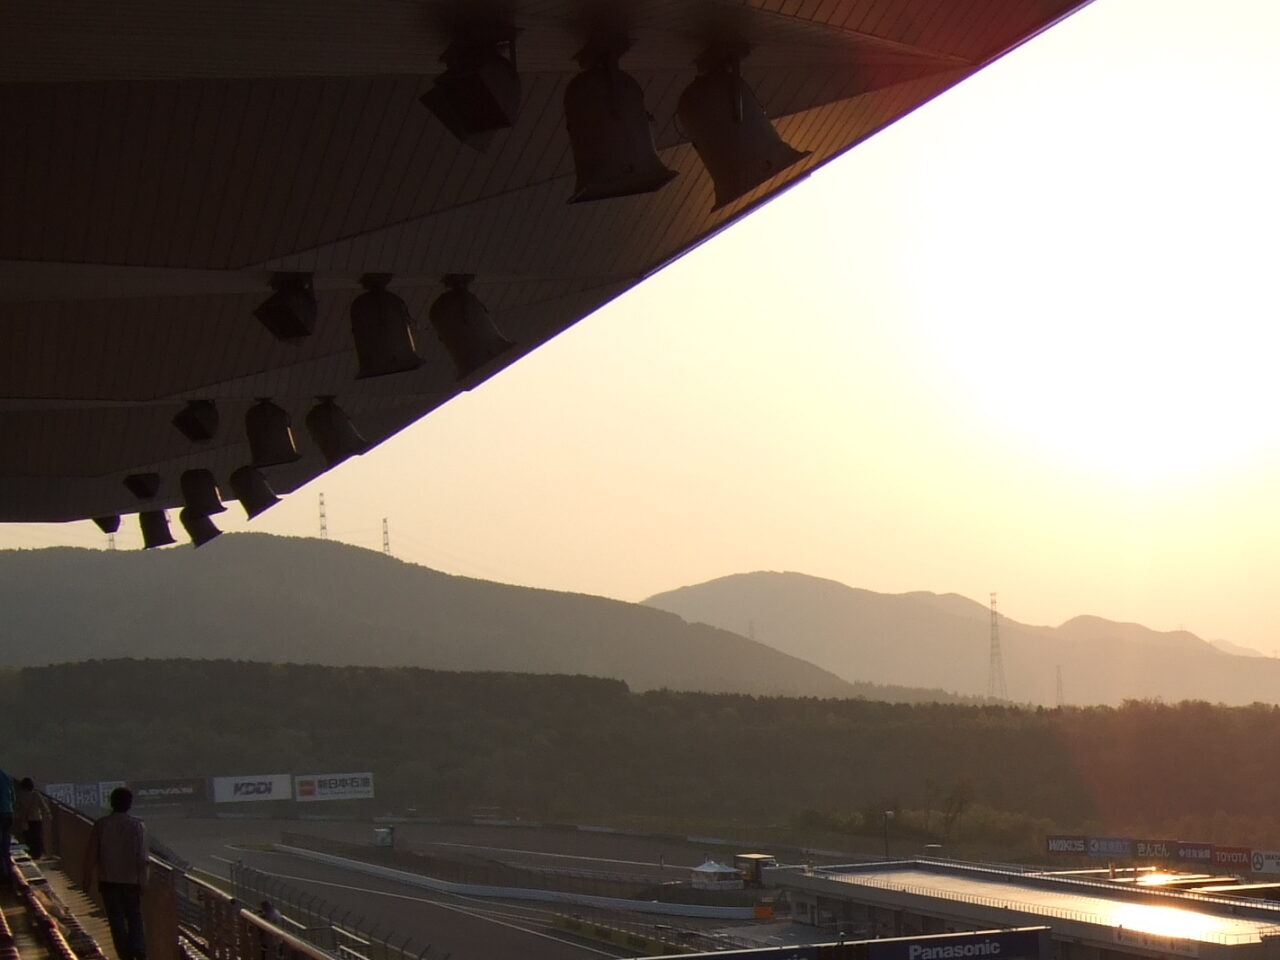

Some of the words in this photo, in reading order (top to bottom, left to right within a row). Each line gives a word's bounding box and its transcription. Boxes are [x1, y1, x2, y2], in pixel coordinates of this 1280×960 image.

[233, 781, 273, 796] KDDI
[317, 777, 370, 790] 新日本石油
[138, 787, 193, 796] ADVAN
[1136, 842, 1170, 857] きんでん
[1216, 852, 1248, 864] TOYOTA
[908, 938, 1001, 960] Panasonic
